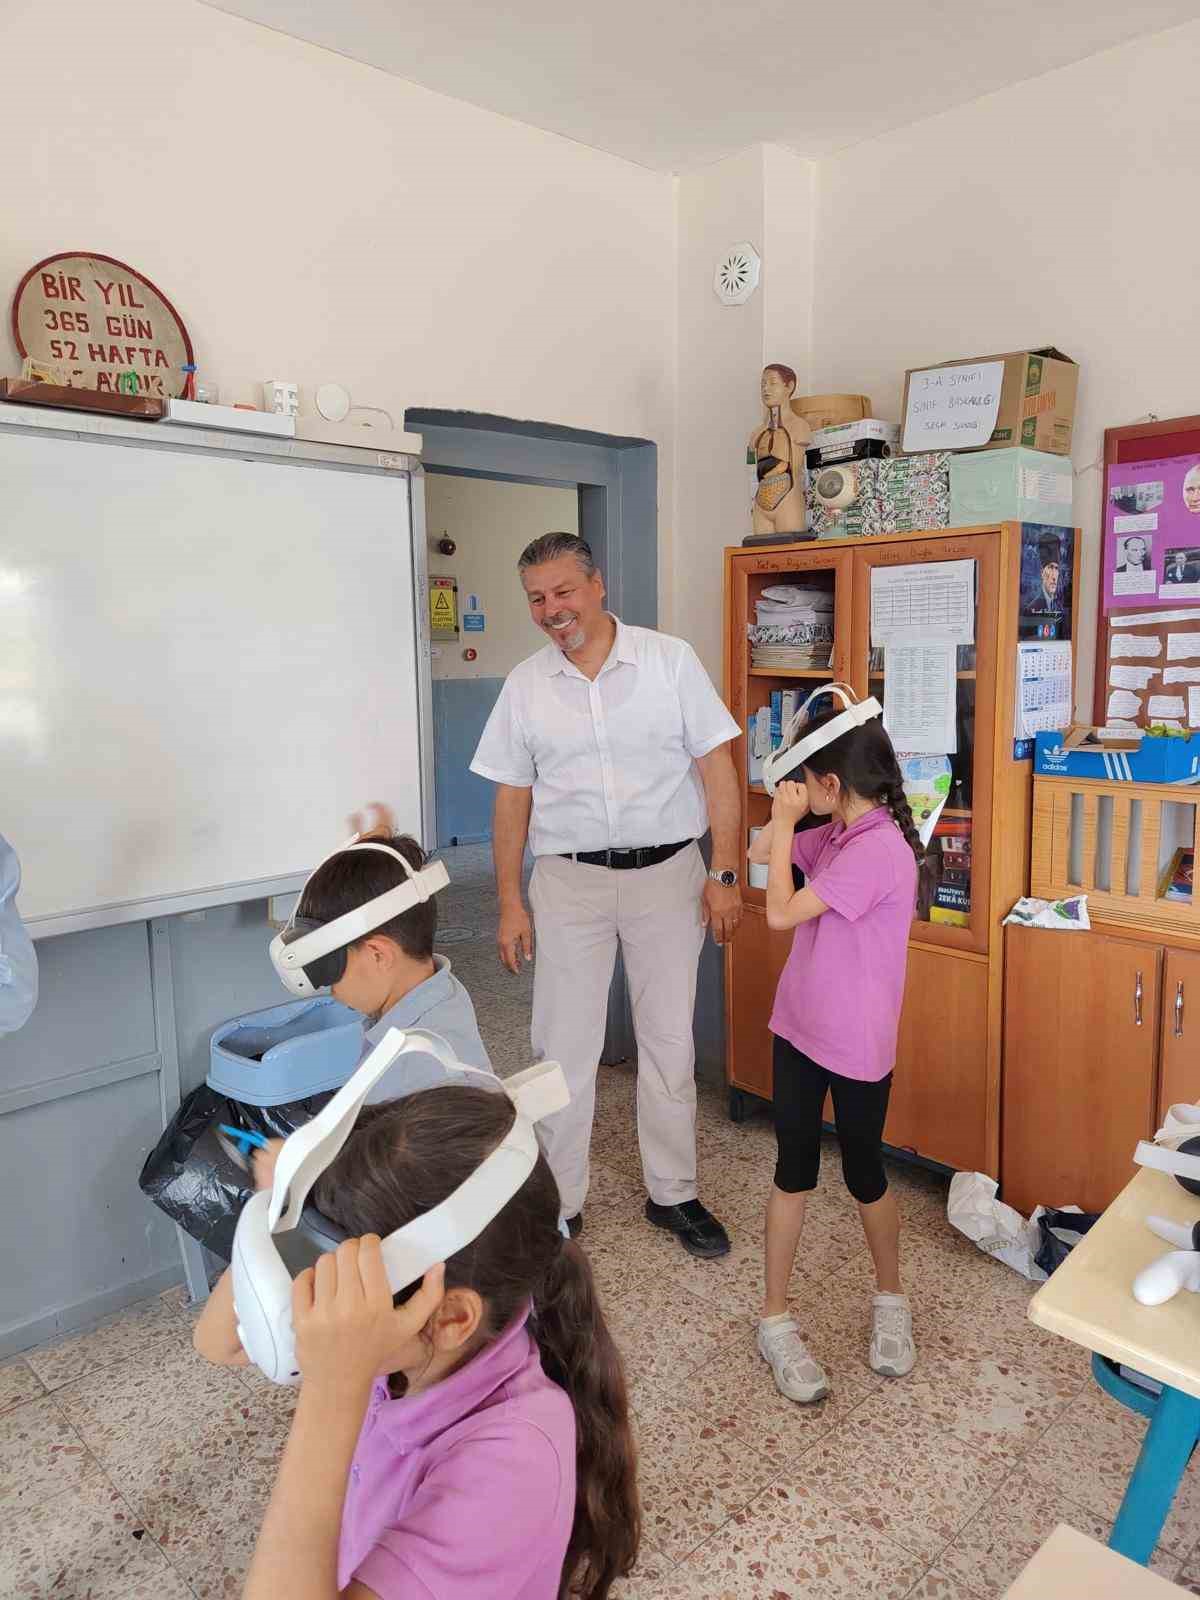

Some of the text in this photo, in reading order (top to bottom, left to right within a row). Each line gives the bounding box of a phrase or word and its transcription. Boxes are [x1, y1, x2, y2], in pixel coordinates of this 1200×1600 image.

[41, 271, 145, 309] BİR YIL
[44, 309, 153, 340] 365 GÜN
[51, 340, 170, 369] 52 HAFTA
[1042, 763, 1068, 772] adidas
